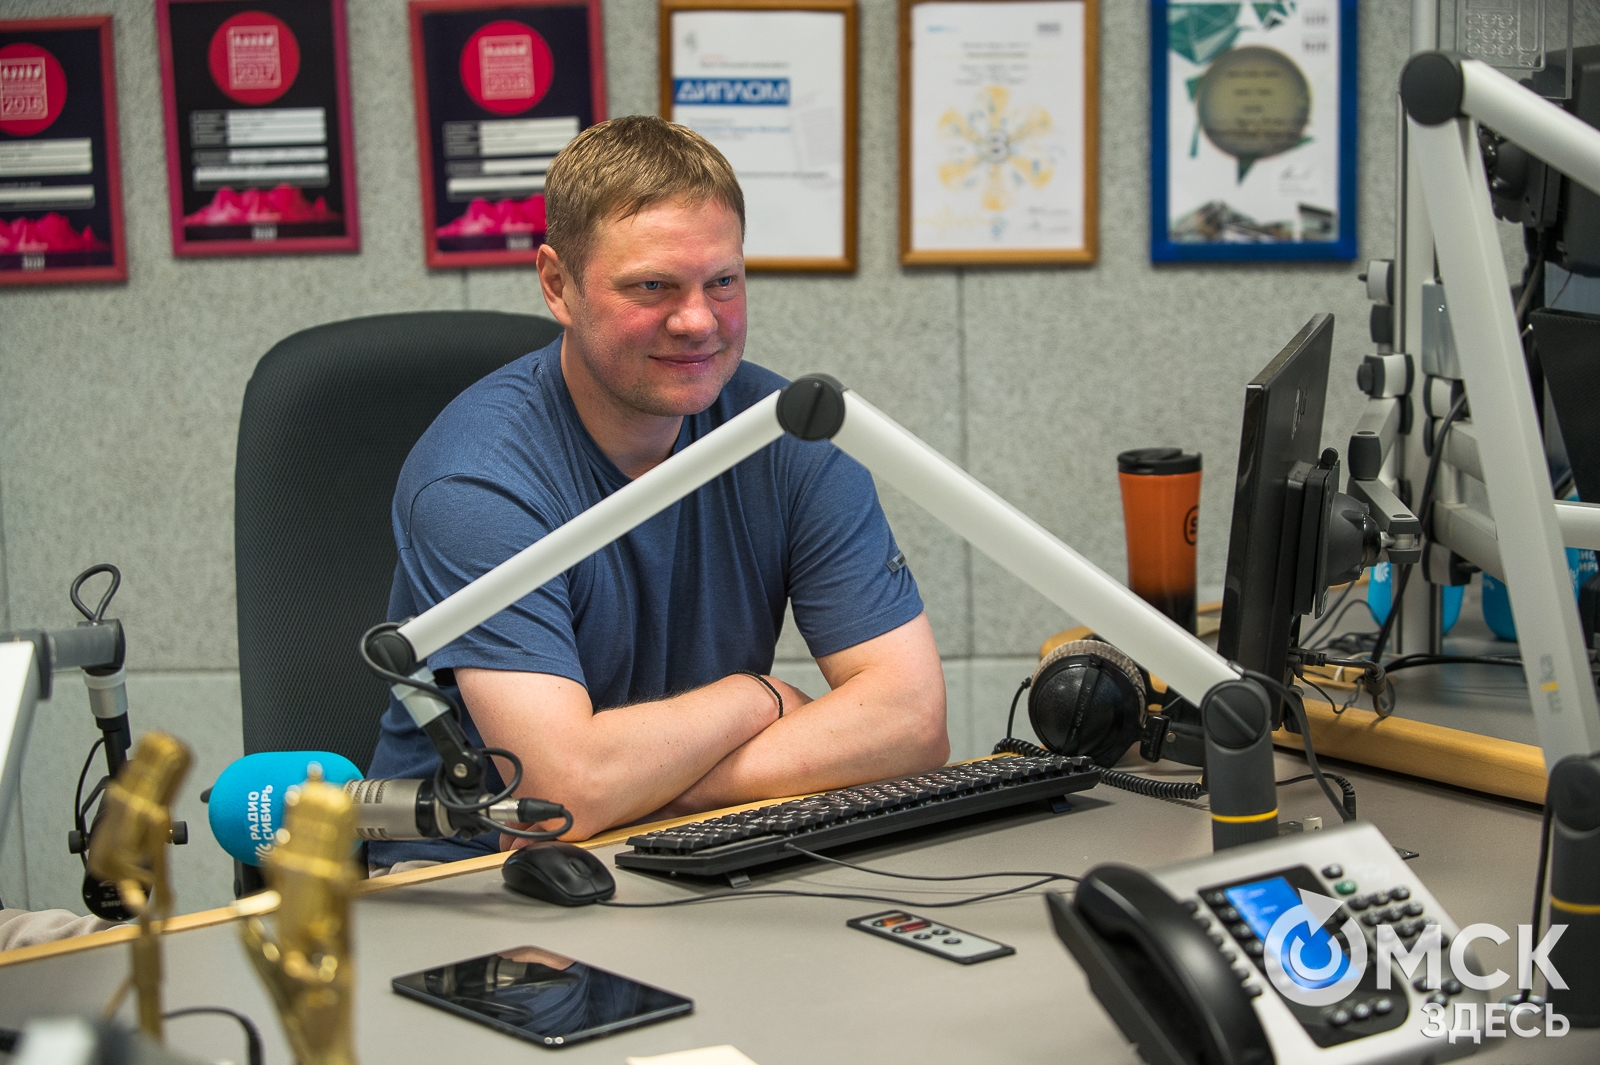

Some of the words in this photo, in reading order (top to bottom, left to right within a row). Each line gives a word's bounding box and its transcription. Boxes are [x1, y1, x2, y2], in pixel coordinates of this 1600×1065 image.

[678, 81, 788, 102] ДИПЛОМ
[248, 791, 262, 840] РАДИО
[260, 785, 274, 840] СИБИРЬ
